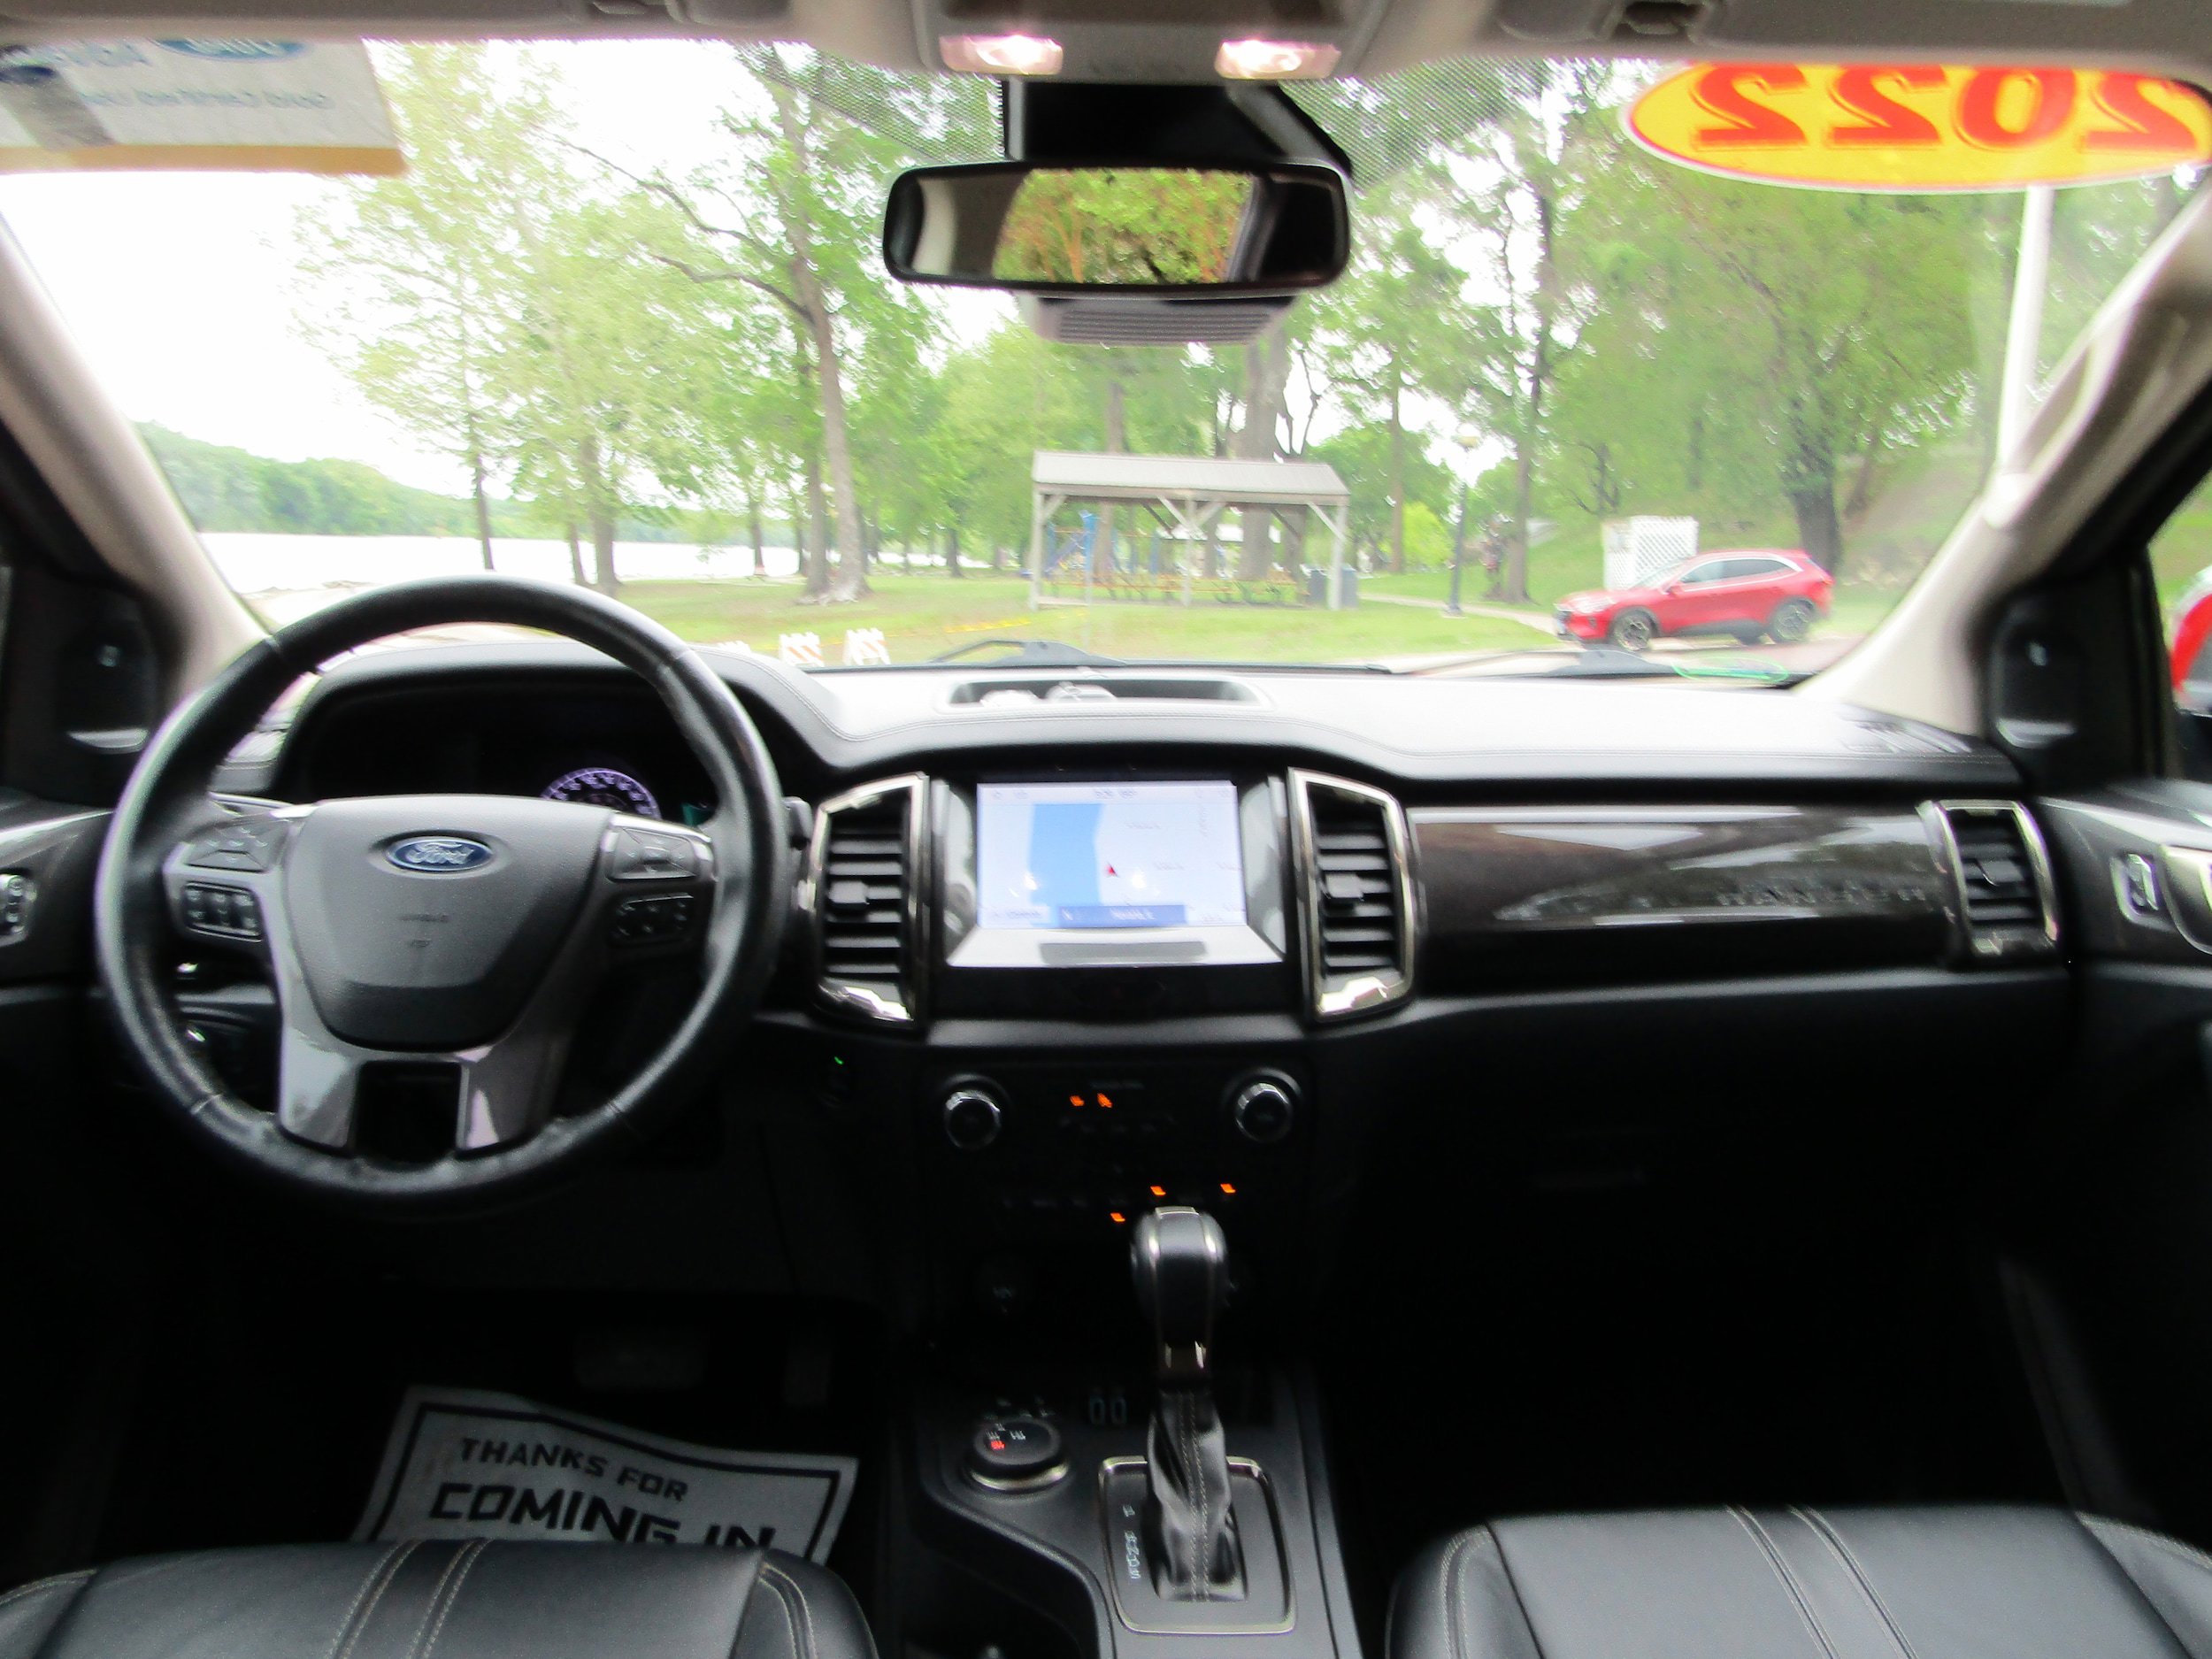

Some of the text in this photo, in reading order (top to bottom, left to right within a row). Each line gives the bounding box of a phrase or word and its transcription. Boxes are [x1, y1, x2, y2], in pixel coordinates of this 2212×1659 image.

[406, 841, 475, 864] Ford
[460, 1437, 689, 1502] THANKS FOR
